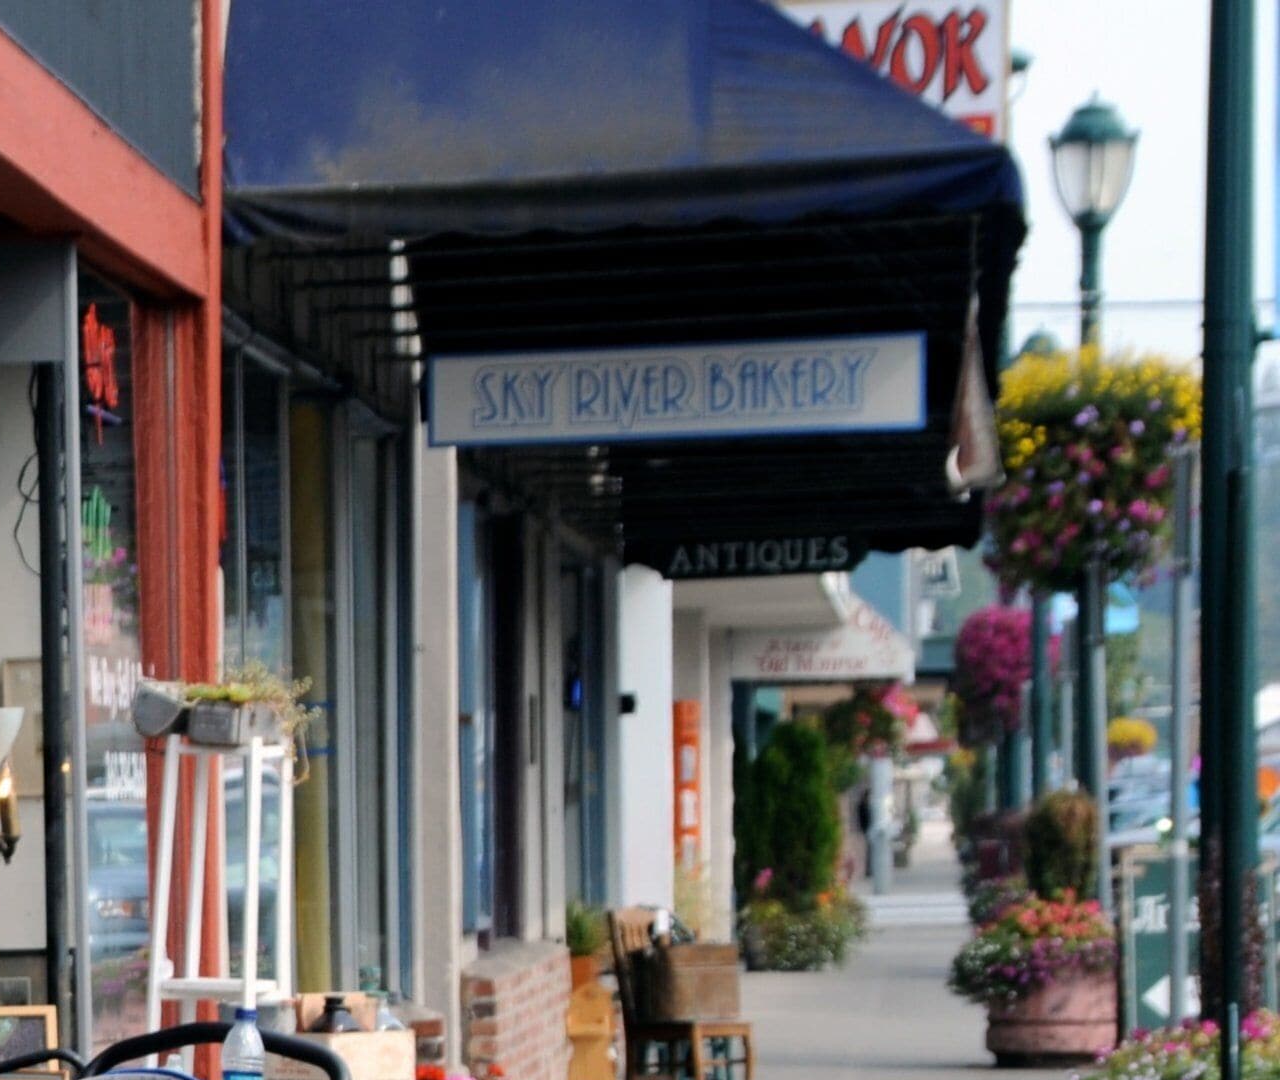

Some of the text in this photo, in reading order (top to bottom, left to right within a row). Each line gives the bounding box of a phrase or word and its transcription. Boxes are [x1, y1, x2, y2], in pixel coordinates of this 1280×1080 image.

[477, 349, 872, 423] SKY RIVER BAKERY
[669, 536, 850, 572] ANTIQUES
